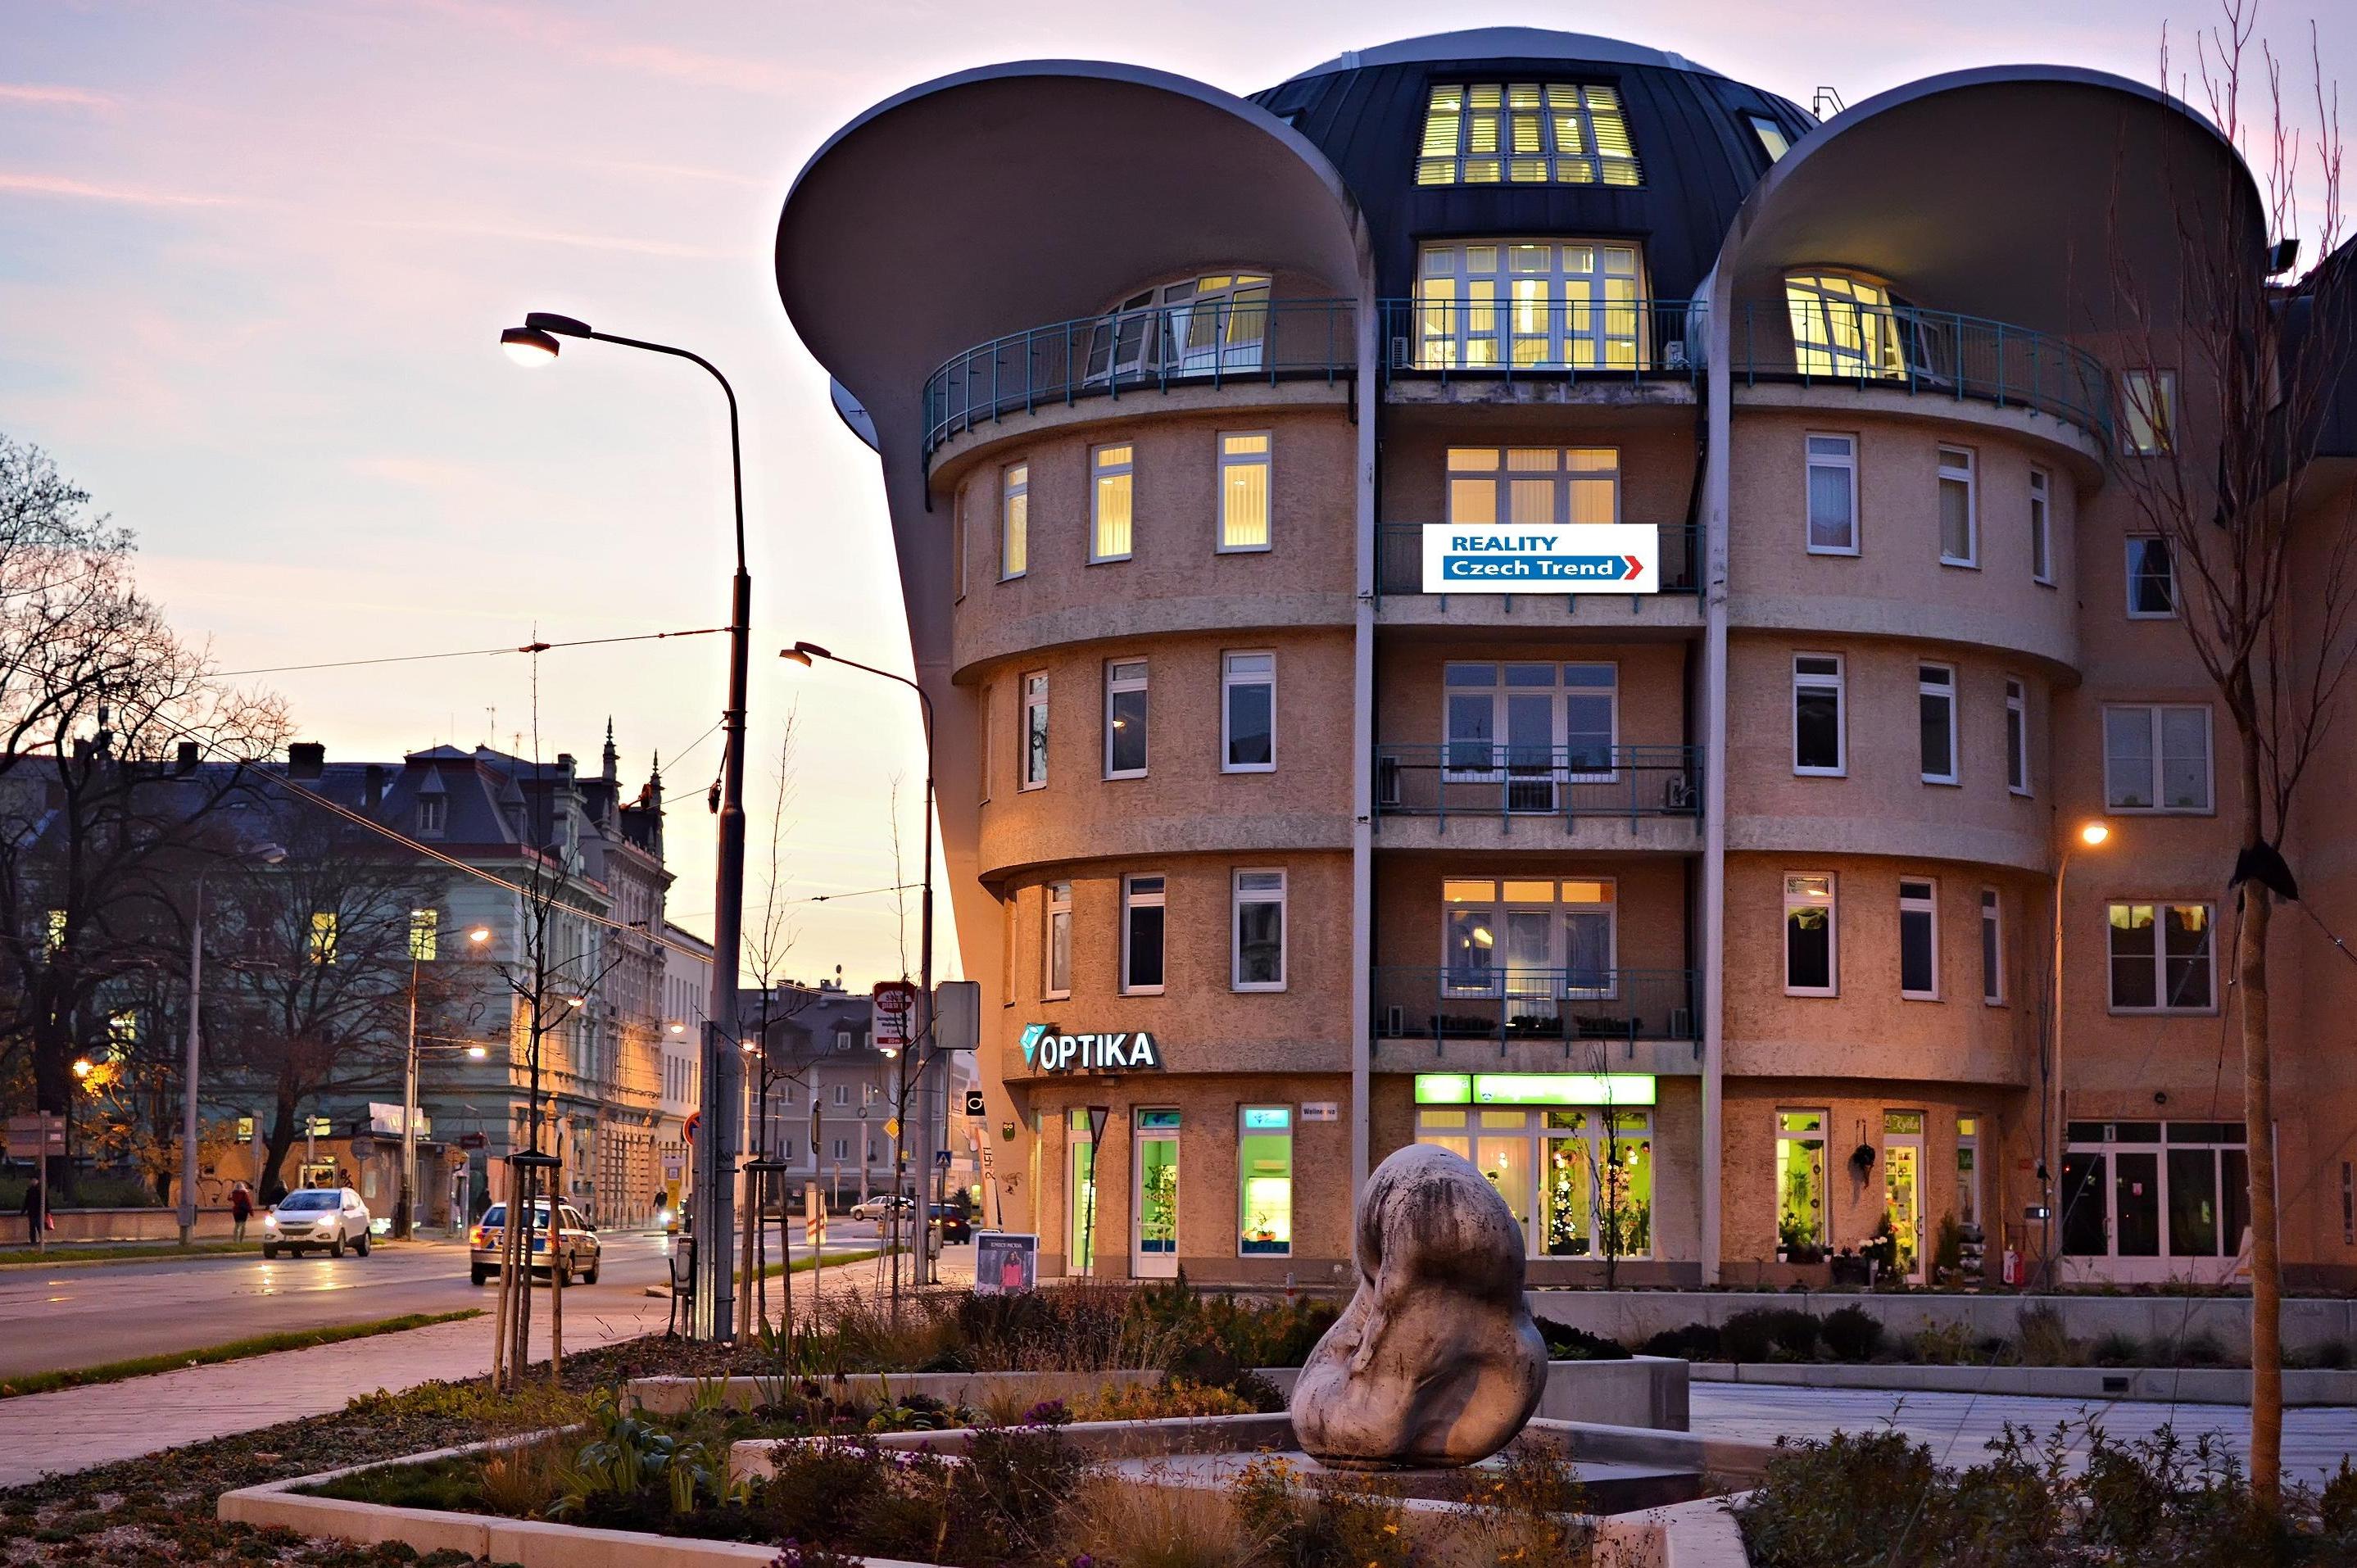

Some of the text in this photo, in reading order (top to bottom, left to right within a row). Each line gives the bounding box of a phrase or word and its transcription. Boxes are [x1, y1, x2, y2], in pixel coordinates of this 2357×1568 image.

[1452, 537, 1559, 551] REALITY
[1451, 560, 1614, 576] Czech Trend
[1040, 1032, 1154, 1071] OPTIKA
